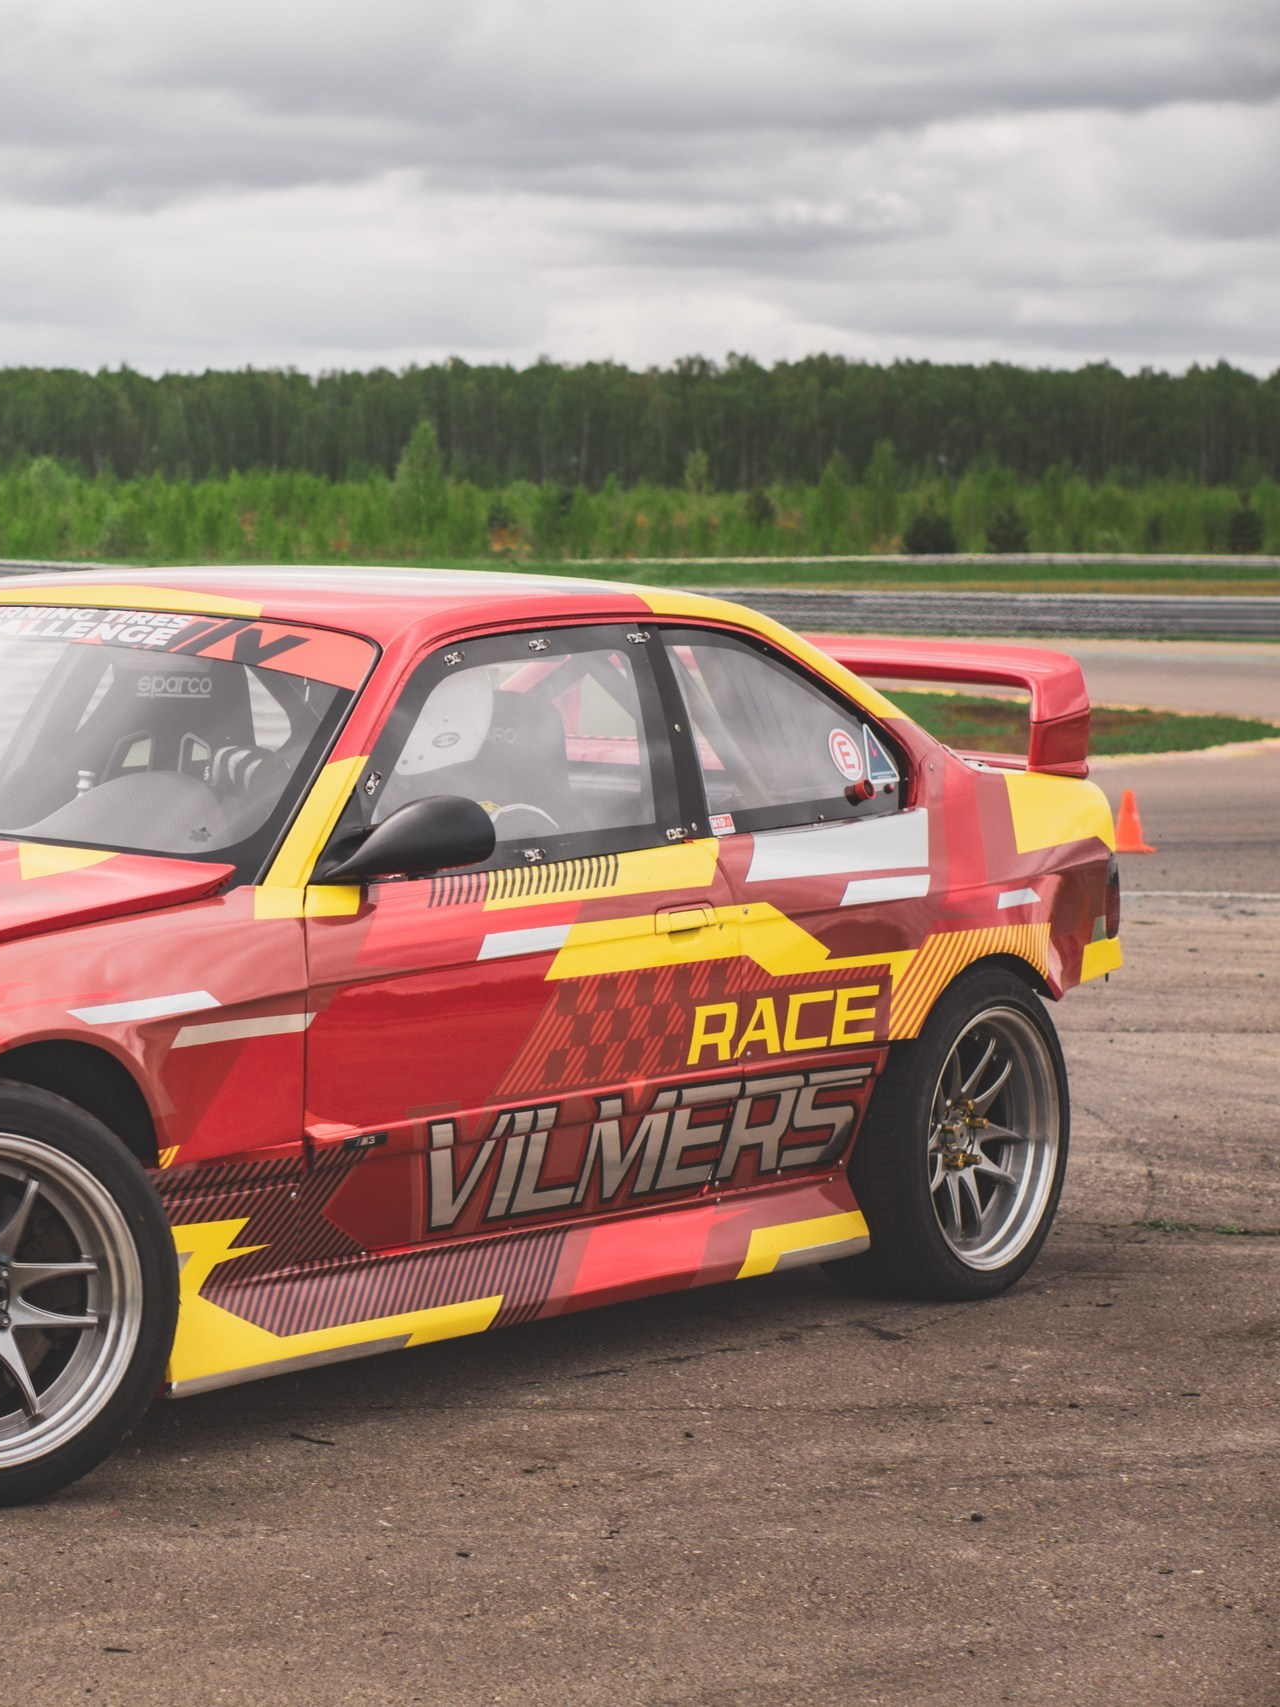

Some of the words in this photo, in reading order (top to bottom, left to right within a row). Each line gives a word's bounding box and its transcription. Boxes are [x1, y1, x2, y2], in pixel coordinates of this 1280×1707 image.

[104, 609, 193, 629] TIRES
[137, 675, 213, 697] sparco
[836, 741, 855, 769] E
[687, 985, 880, 1066] RACE
[428, 1064, 875, 1230] VILMERS
